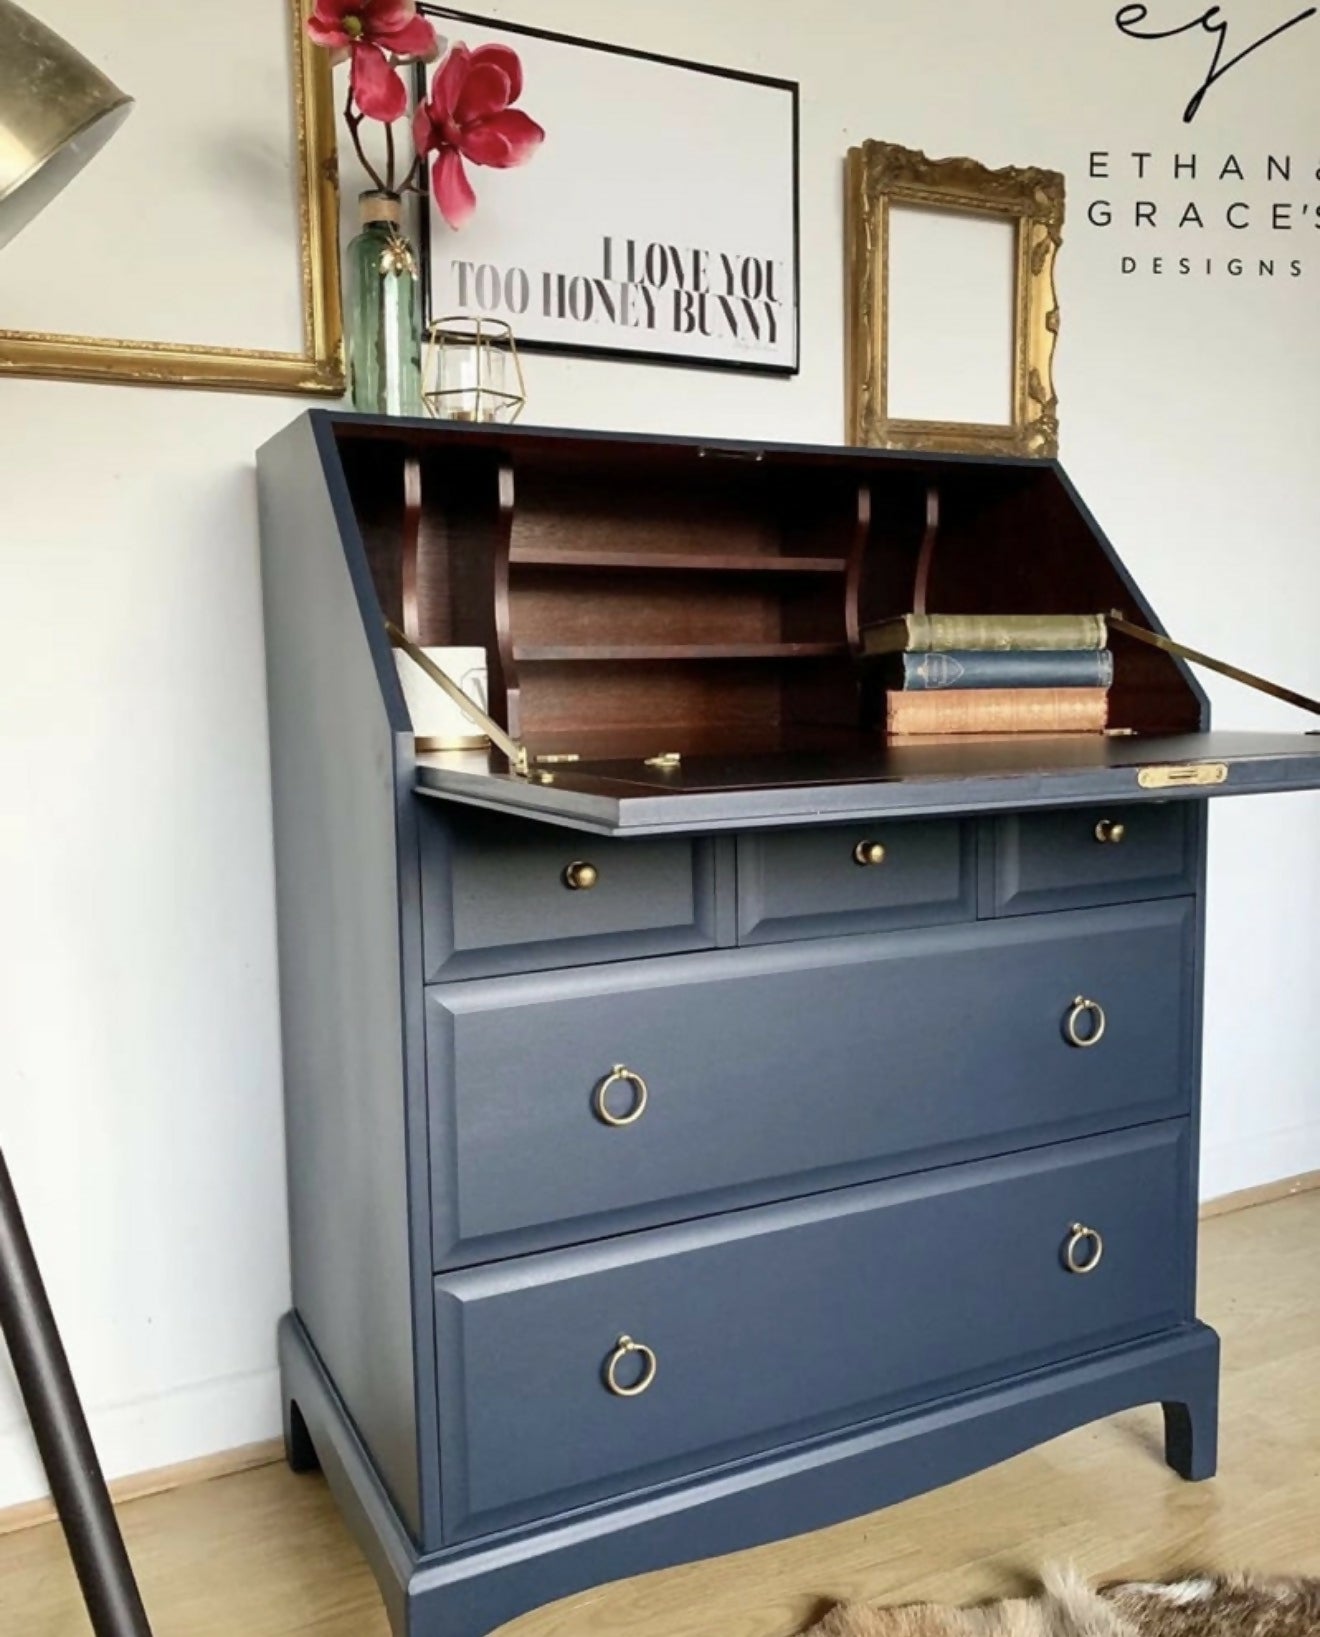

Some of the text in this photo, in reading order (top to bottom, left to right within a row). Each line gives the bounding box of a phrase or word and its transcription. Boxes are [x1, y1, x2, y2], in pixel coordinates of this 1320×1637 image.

[1089, 152, 1290, 181] ETHAN
[602, 236, 784, 303] I LOVE YOU
[1121, 256, 1301, 277] DESIGNS
[451, 260, 779, 344] TOO HONEY BUNNY
